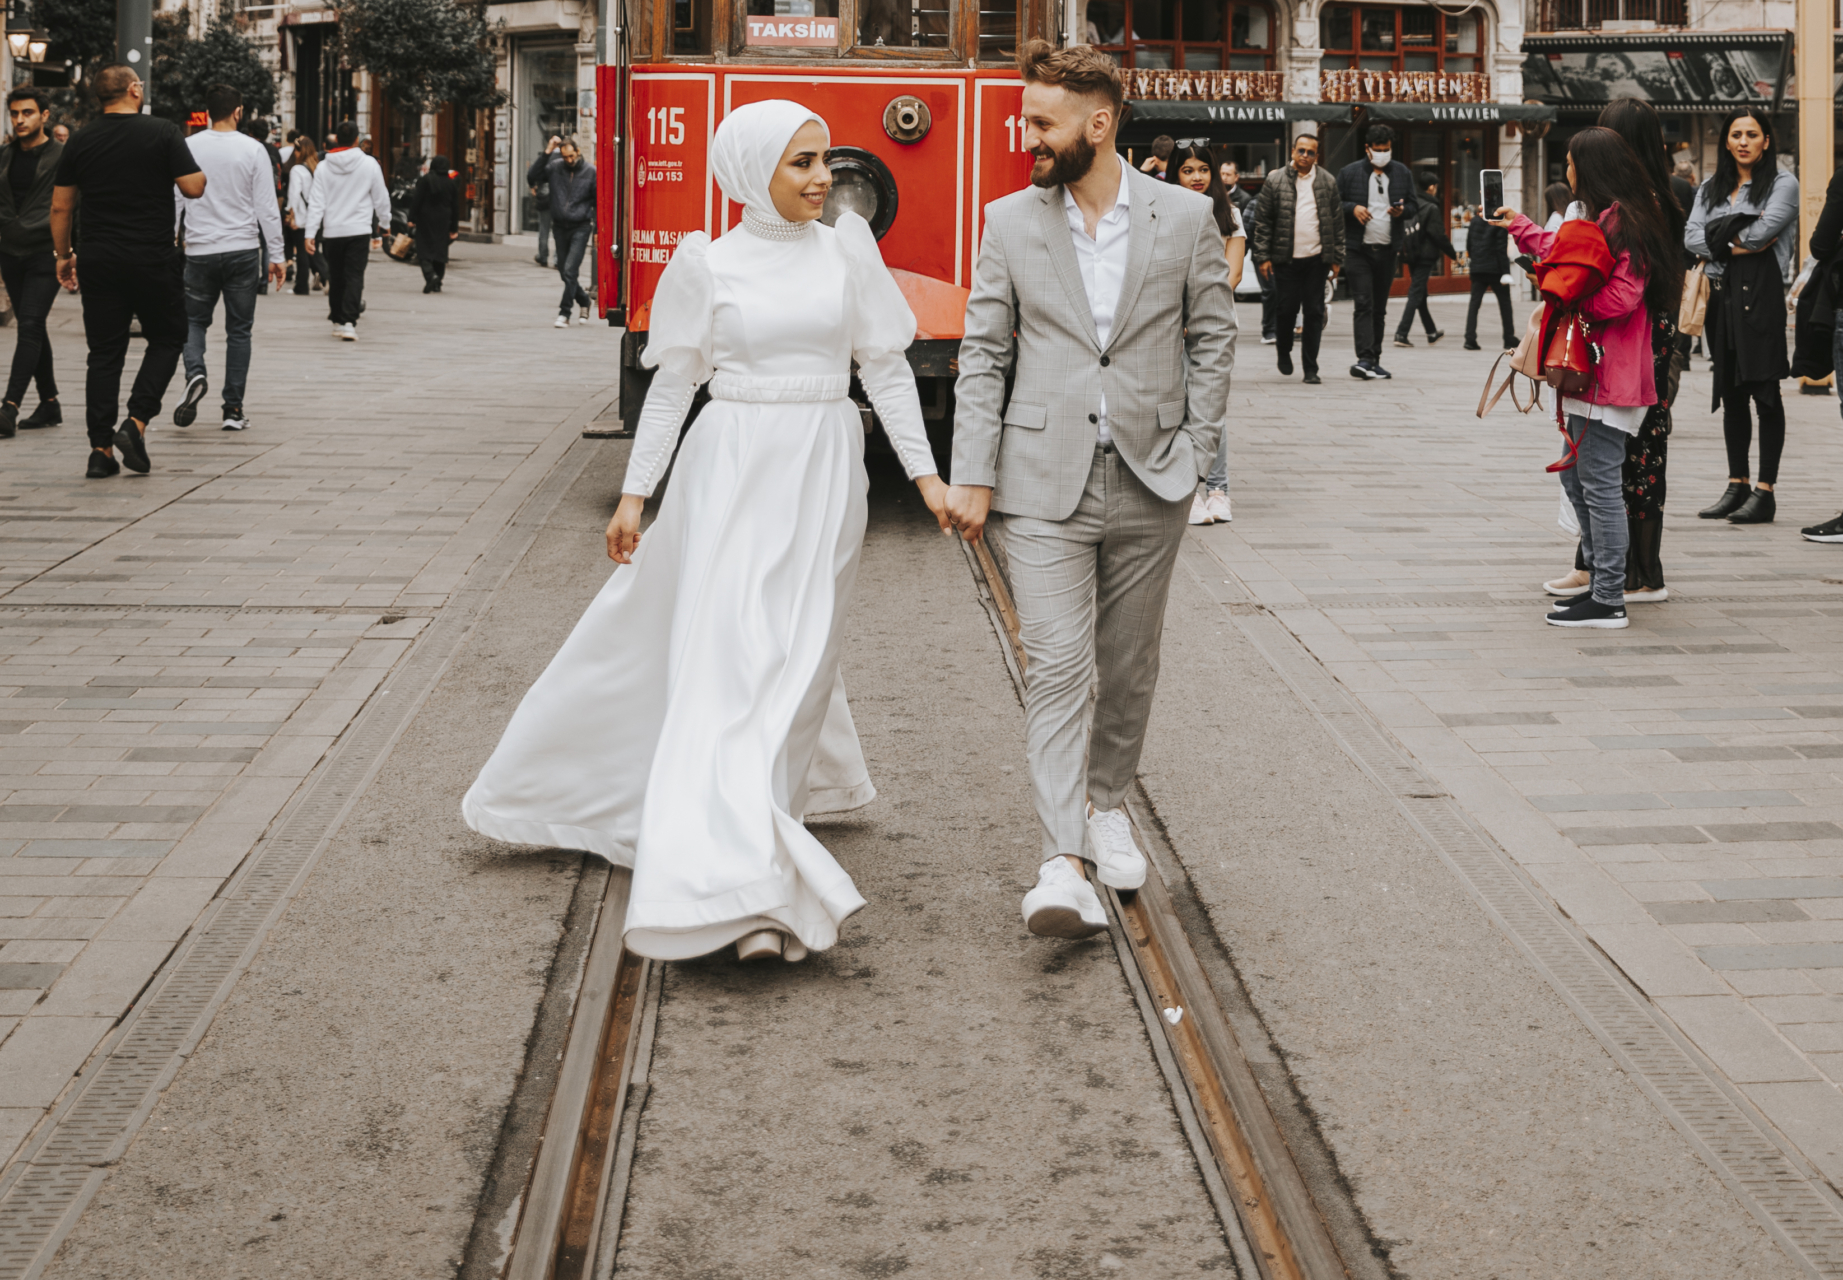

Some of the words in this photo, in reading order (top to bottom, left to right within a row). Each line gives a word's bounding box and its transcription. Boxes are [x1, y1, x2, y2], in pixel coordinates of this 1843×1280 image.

[749, 21, 835, 39] TAKSİM
[1138, 77, 1248, 96] VITAVIEN
[1364, 77, 1462, 96] VITAVIEN
[1208, 106, 1286, 121] VITAVIEN
[1432, 107, 1500, 120] VITAVIEN
[648, 107, 685, 145] 115
[1004, 115, 1026, 152] 11
[647, 171, 664, 182] ALO
[666, 171, 683, 182] 153
[636, 246, 676, 264] TEHLİKEL
